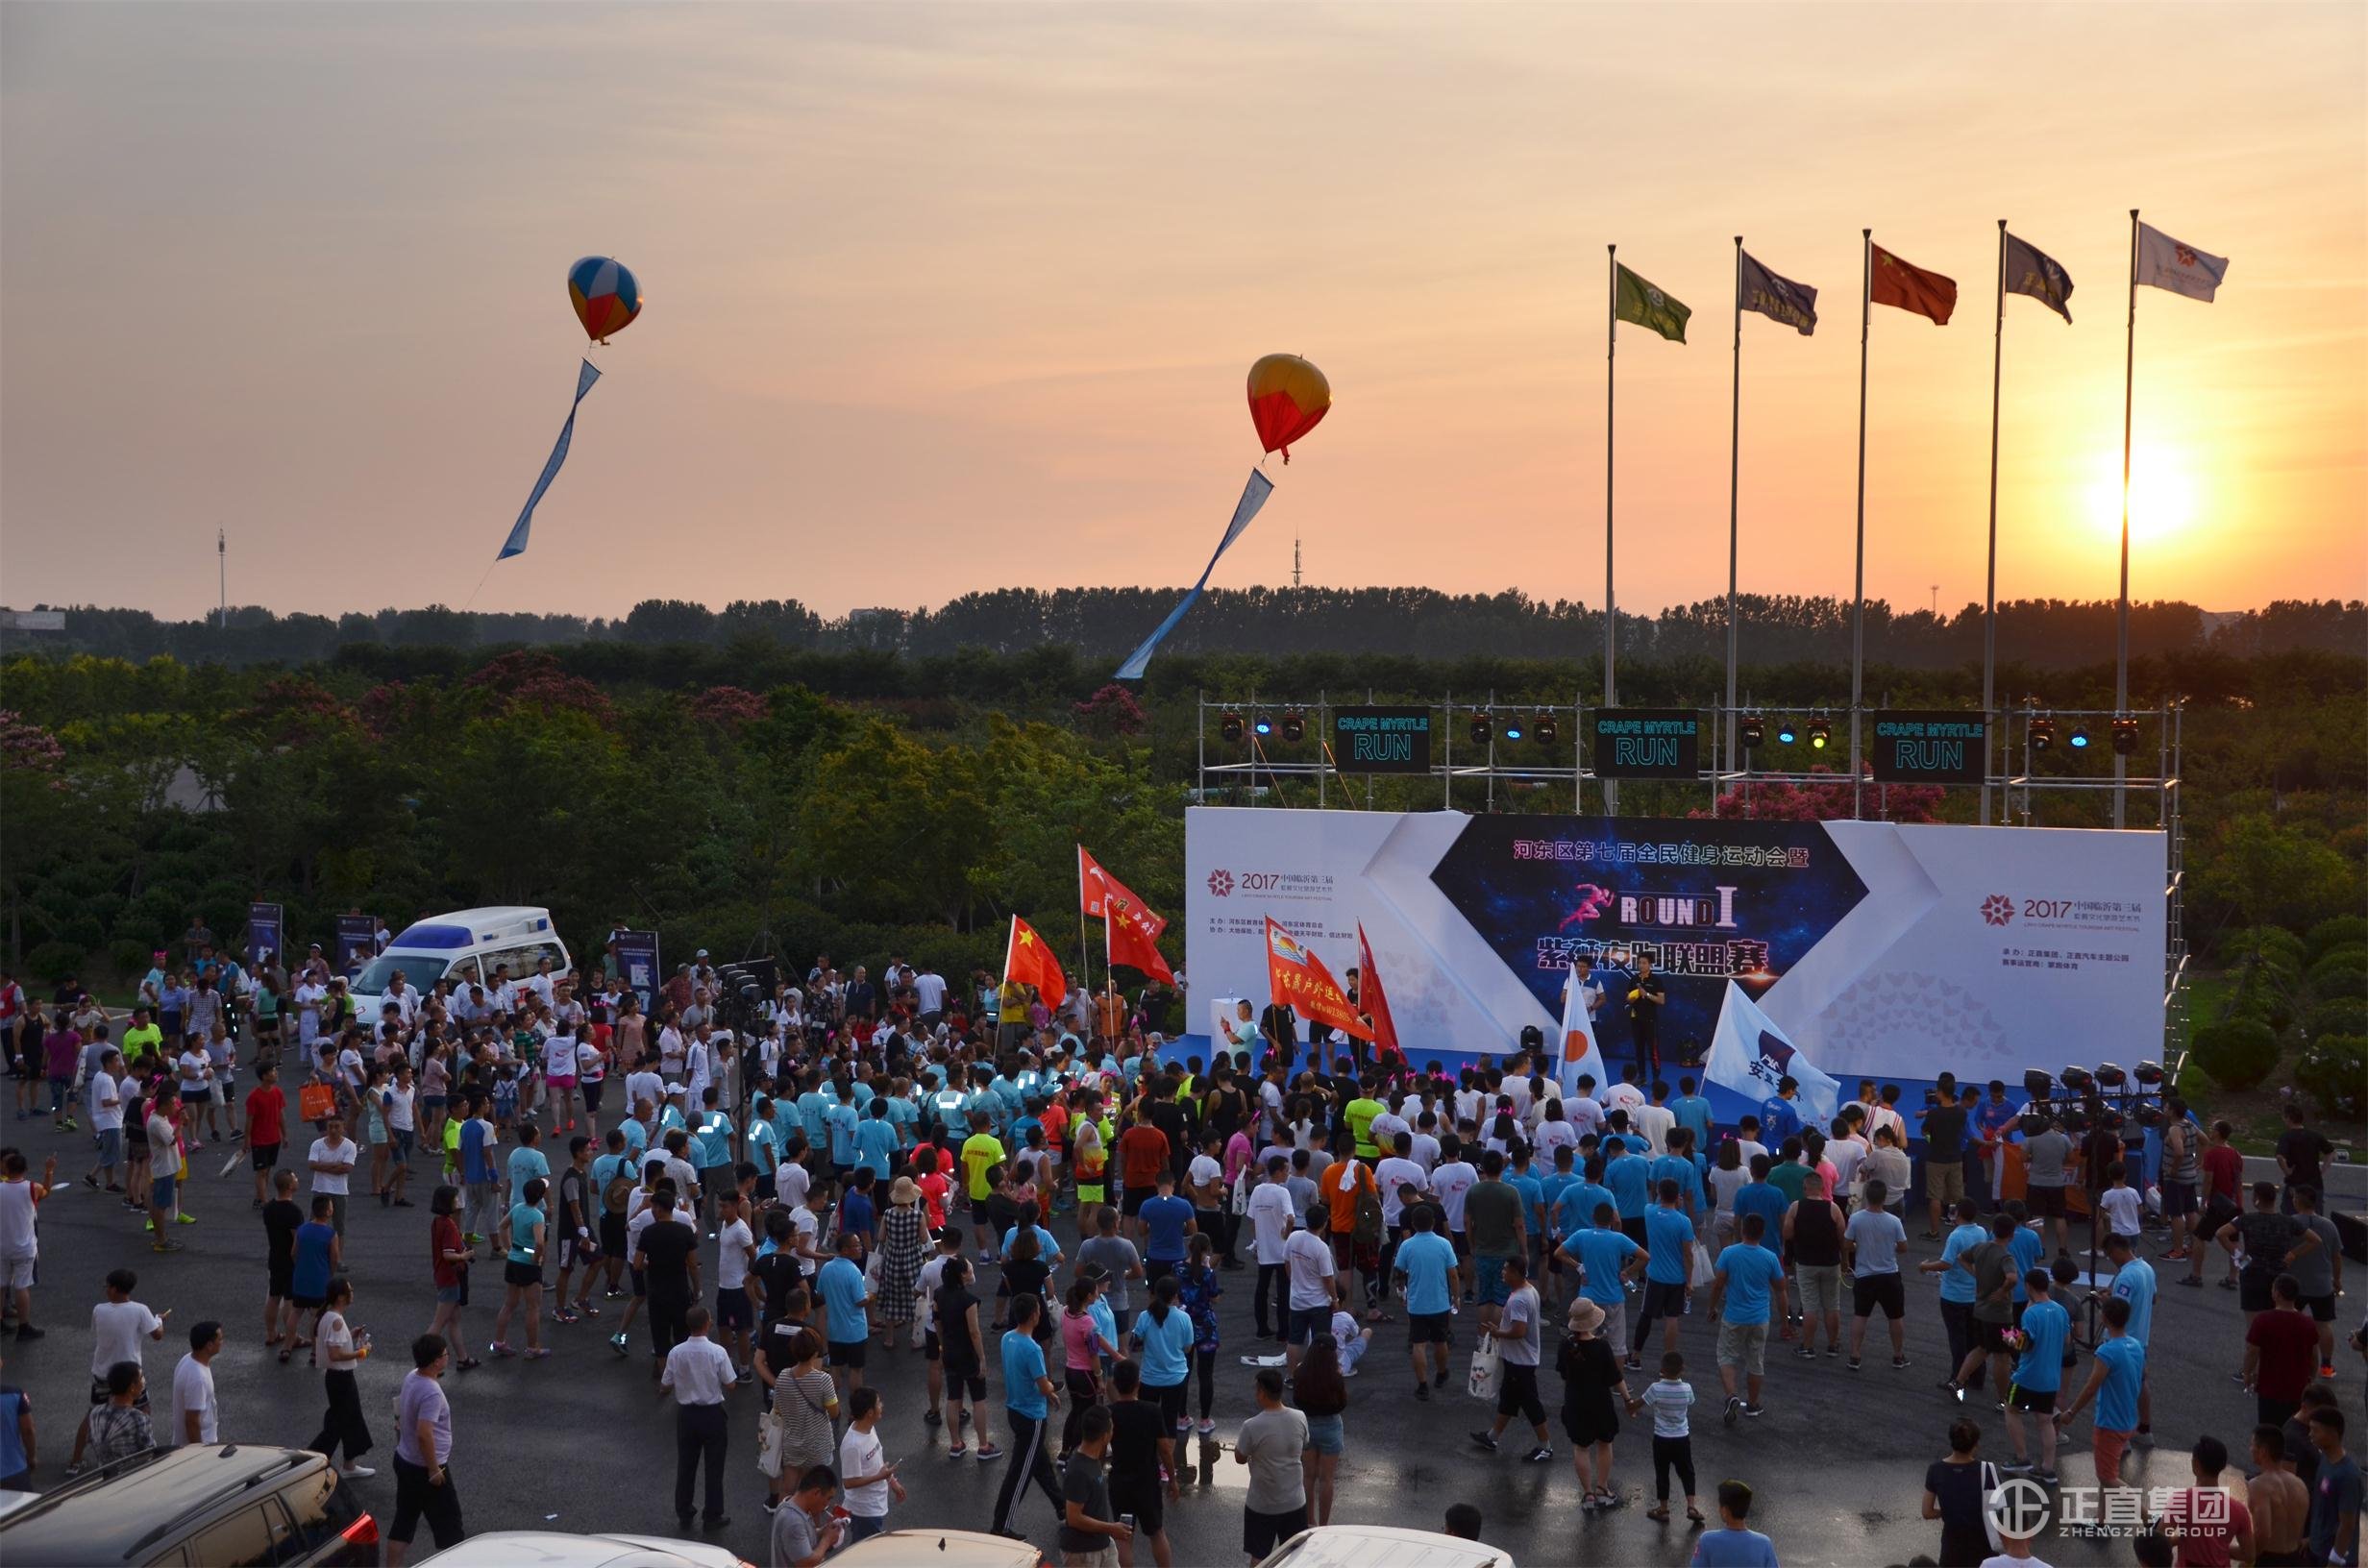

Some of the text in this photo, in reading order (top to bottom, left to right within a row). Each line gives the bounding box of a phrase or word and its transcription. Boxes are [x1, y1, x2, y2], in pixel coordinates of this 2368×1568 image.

[1338, 718, 1428, 730] CRAPE MYRTLE
[1598, 721, 1696, 735] CRAPE MYRTLE
[1876, 723, 1984, 738] CRAPE MYRTLE
[1354, 734, 1411, 760] RUN
[1616, 738, 1677, 766] RUN
[1896, 740, 1962, 769] RUN
[1514, 840, 1809, 868] 河东区第七届全民健身运动会暨
[1242, 873, 1279, 890] 2017
[1621, 896, 1714, 926] ROUND
[2025, 900, 2072, 918] 2017
